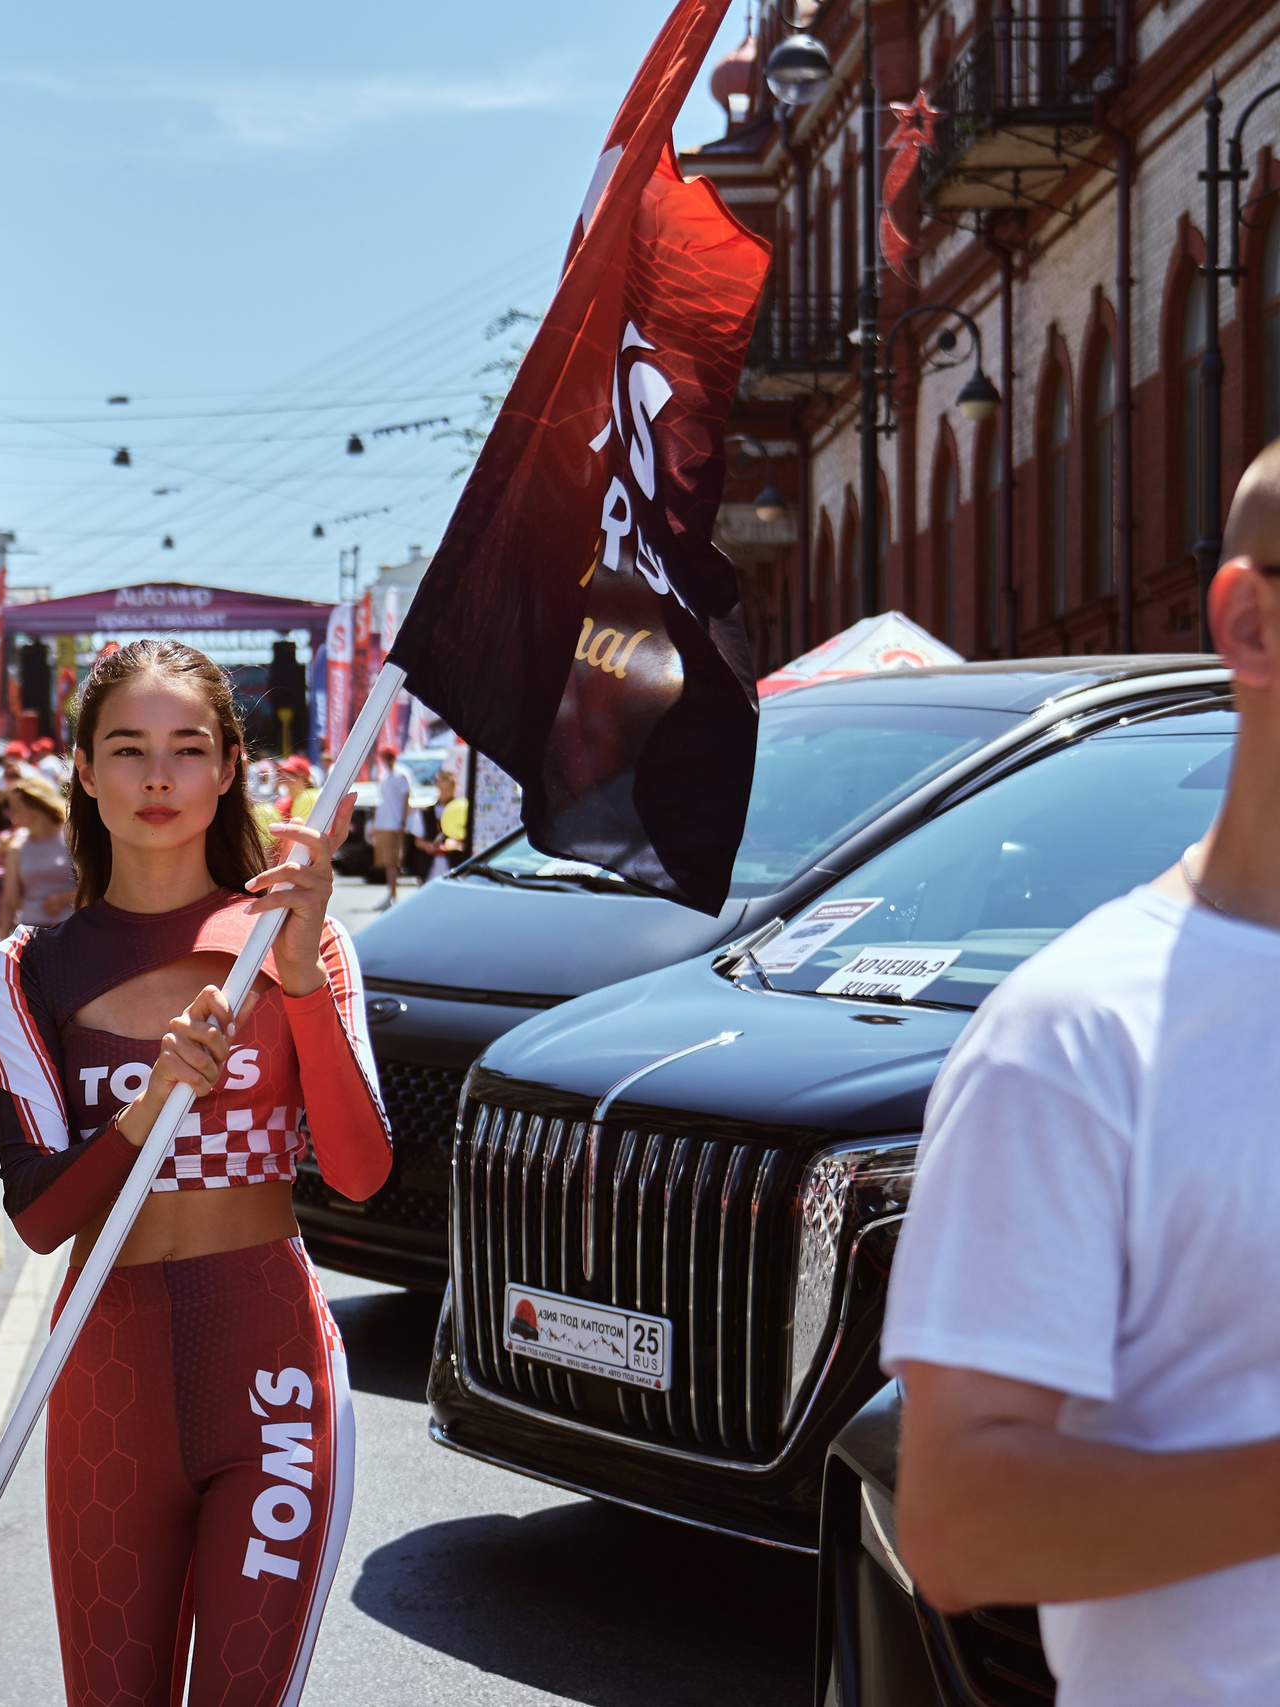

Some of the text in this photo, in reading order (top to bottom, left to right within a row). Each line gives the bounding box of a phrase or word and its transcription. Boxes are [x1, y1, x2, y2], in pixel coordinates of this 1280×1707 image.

[843, 958, 946, 978] ХОЧЕШЬ?
[79, 1044, 261, 1104] TO'S
[537, 1308, 625, 1340] АЗИЯ ПОД КАПОТОМ
[632, 1323, 660, 1355] 25
[608, 1368, 652, 1386] АВТО ПОД ЗАКАЗ
[633, 1353, 659, 1371] RUS
[241, 1366, 314, 1581] TOM'S
